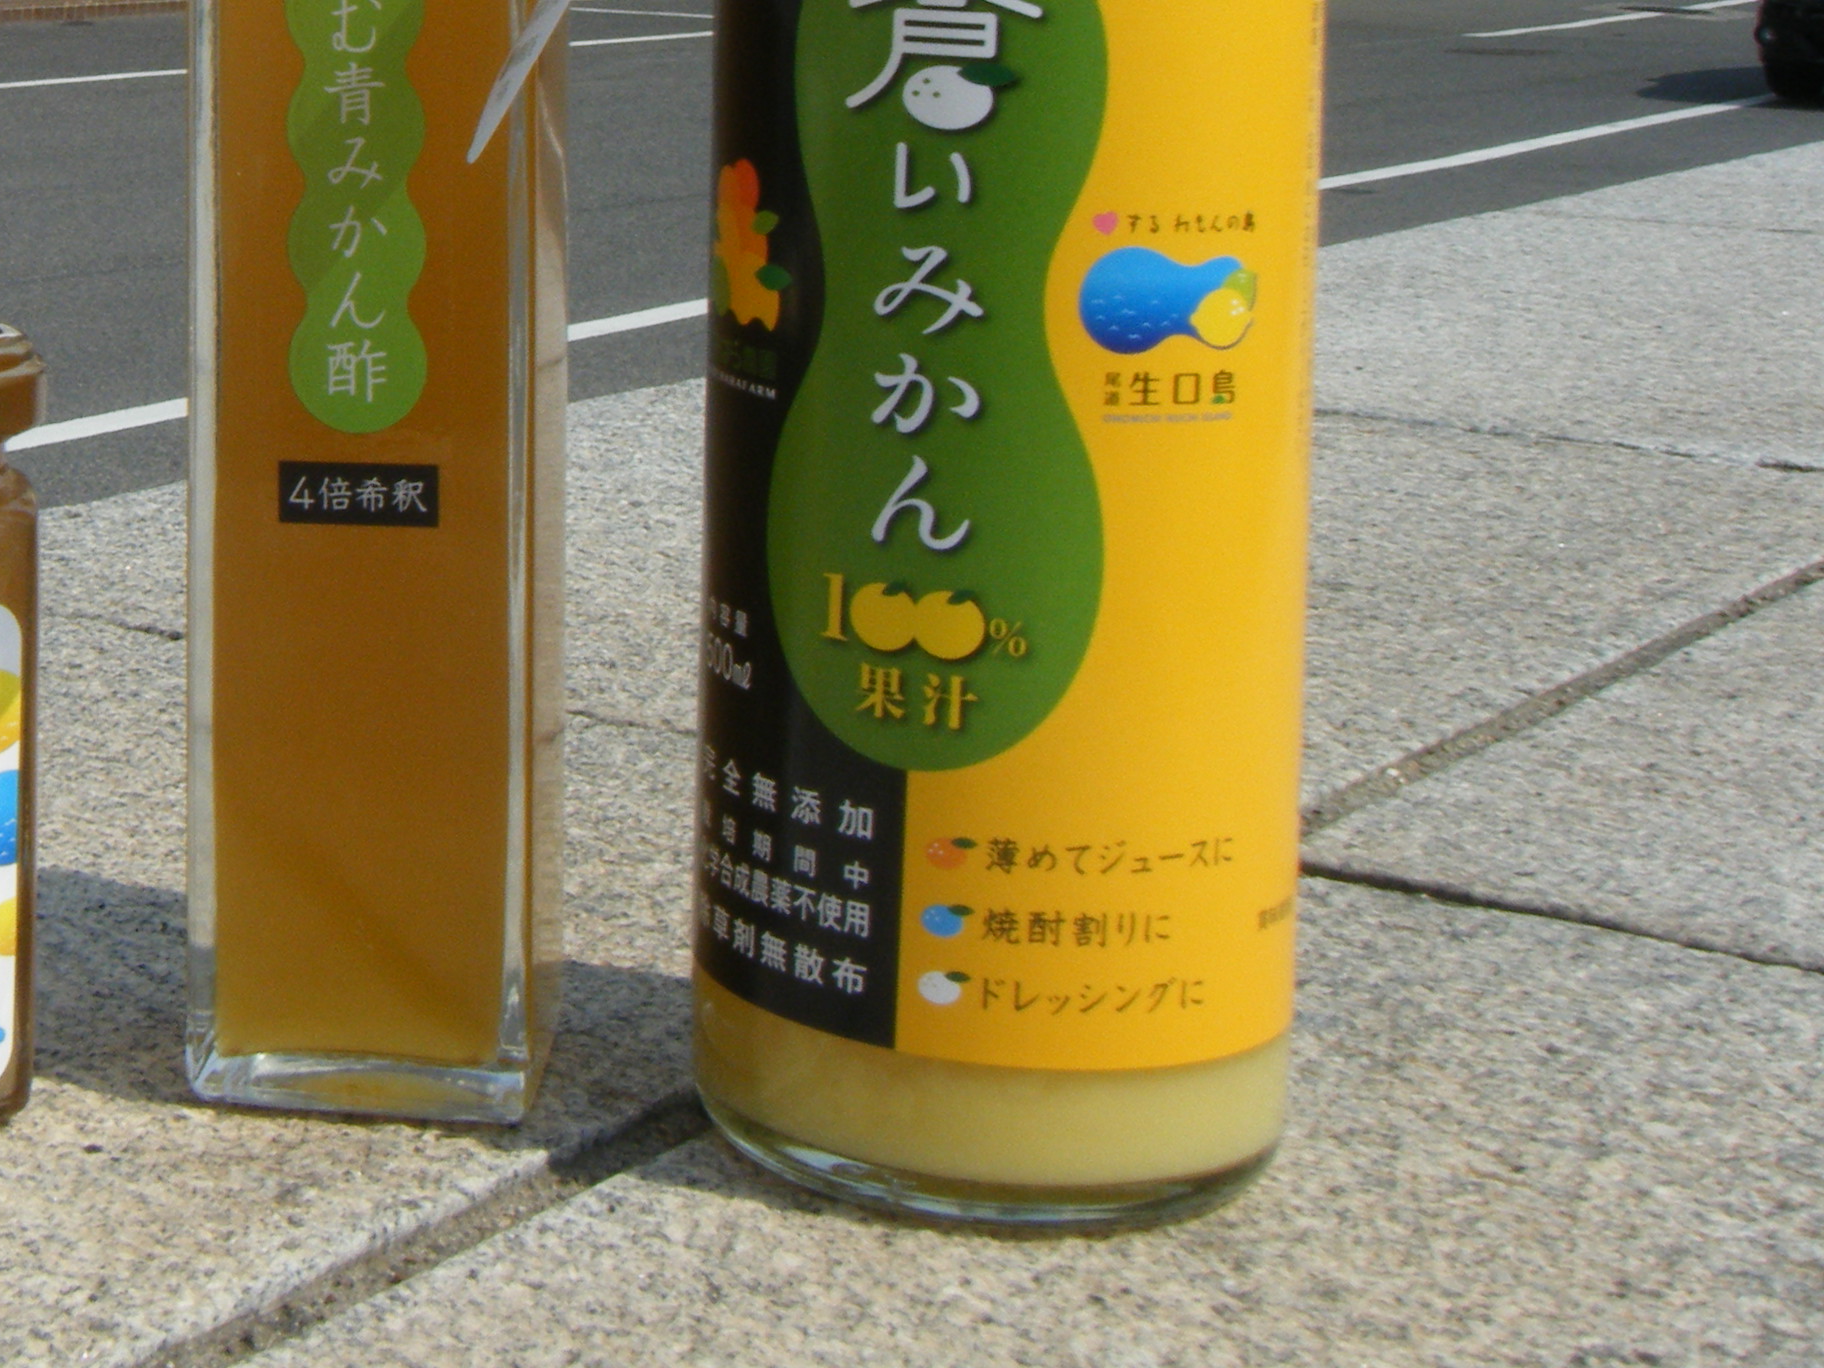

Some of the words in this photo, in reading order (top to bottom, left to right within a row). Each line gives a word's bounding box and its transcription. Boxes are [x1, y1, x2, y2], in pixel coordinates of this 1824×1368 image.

[289, 477, 427, 513] 4倍希釈
[856, 662, 979, 731] 果汁
[985, 837, 1234, 875] 薄めてジュースに
[981, 907, 1172, 948] 焼酎割りに
[980, 977, 1204, 1016] ドレッシングに
